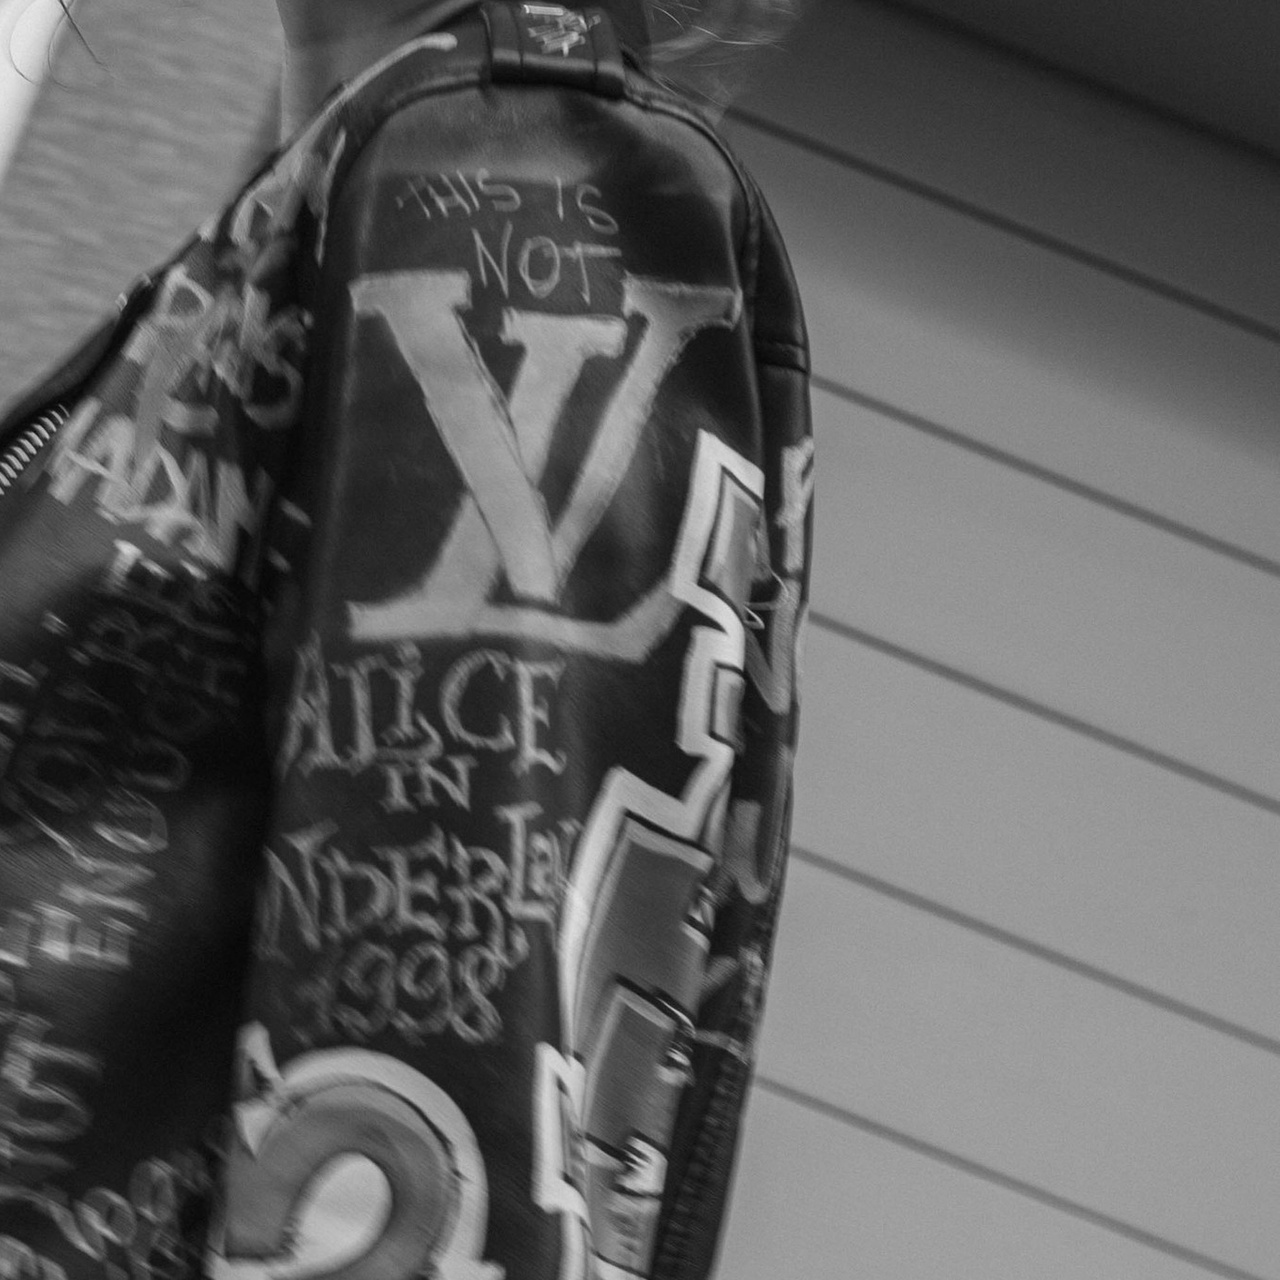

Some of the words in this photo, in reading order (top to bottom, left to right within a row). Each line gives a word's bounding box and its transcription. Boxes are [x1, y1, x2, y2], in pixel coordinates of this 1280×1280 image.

[395, 167, 521, 221] THIS
[553, 175, 619, 234] IS
[470, 218, 622, 305] NOT
[378, 753, 479, 813] IN
